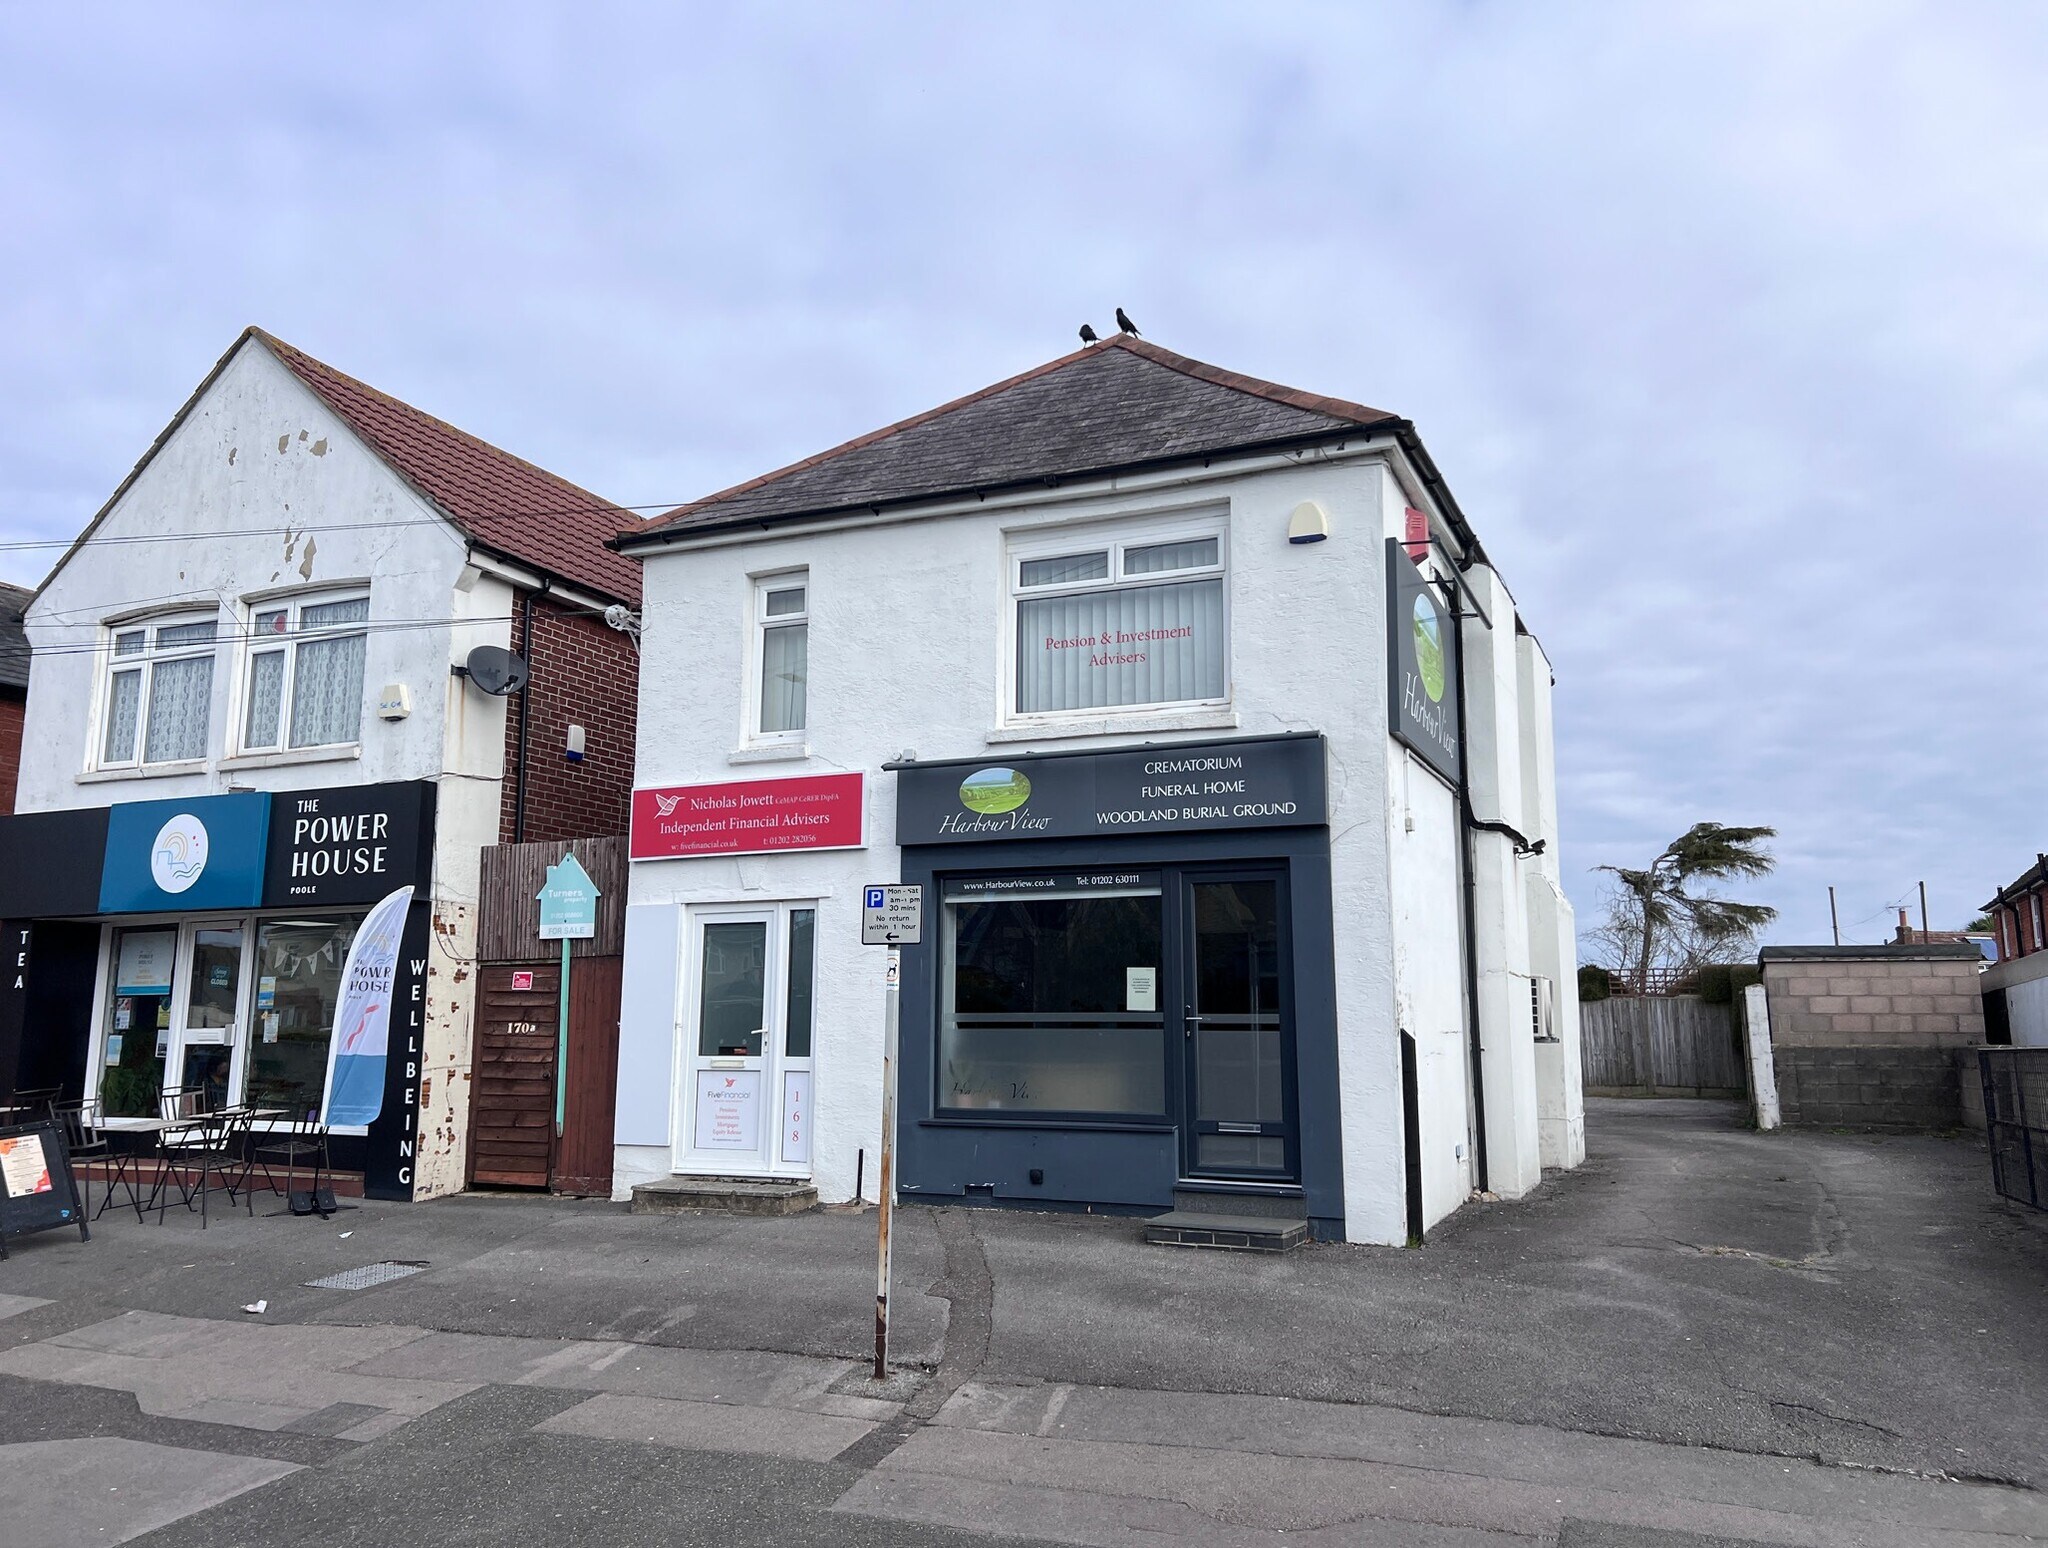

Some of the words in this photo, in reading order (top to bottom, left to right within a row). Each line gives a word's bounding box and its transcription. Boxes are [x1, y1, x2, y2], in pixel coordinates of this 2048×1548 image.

[1045, 635, 1096, 650] Pension
[1100, 631, 1112, 645] &
[1116, 625, 1192, 644] Investment
[1088, 652, 1146, 667] Advisers
[1144, 757, 1242, 775] CREMATORIUM
[1141, 783, 1199, 798] FUNERAL
[1204, 780, 1246, 794] HOME
[297, 799, 320, 813] THE
[690, 796, 737, 810] Nicholas
[739, 795, 774, 809] Jowett
[1096, 808, 1178, 825] WOODLAND
[1182, 805, 1229, 820] BURIAL
[1233, 801, 1297, 817] GROUND
[294, 813, 389, 845] POWER
[660, 819, 726, 836] Independent
[729, 814, 779, 830] Financial
[782, 812, 830, 826] Advisers
[680, 838, 739, 850] fivefinancial.co.uk
[769, 836, 790, 845] 01202
[791, 835, 816, 844] 282056
[291, 846, 388, 877] HOUSE
[290, 885, 317, 894] POOLE
[963, 879, 1055, 890] www.HarbourView.co.uk
[1076, 876, 1089, 885] Tel:
[1091, 875, 1113, 885] 01202
[1115, 875, 1140, 884] 630111
[547, 889, 583, 898] Turners
[871, 891, 882, 907] P
[548, 927, 562, 935] FOR
[564, 926, 585, 935] SALE
[14, 930, 29, 989] TEA
[354, 966, 392, 979] POWR
[507, 1022, 536, 1034] 170a
[398, 959, 426, 1184] WELLBEING
